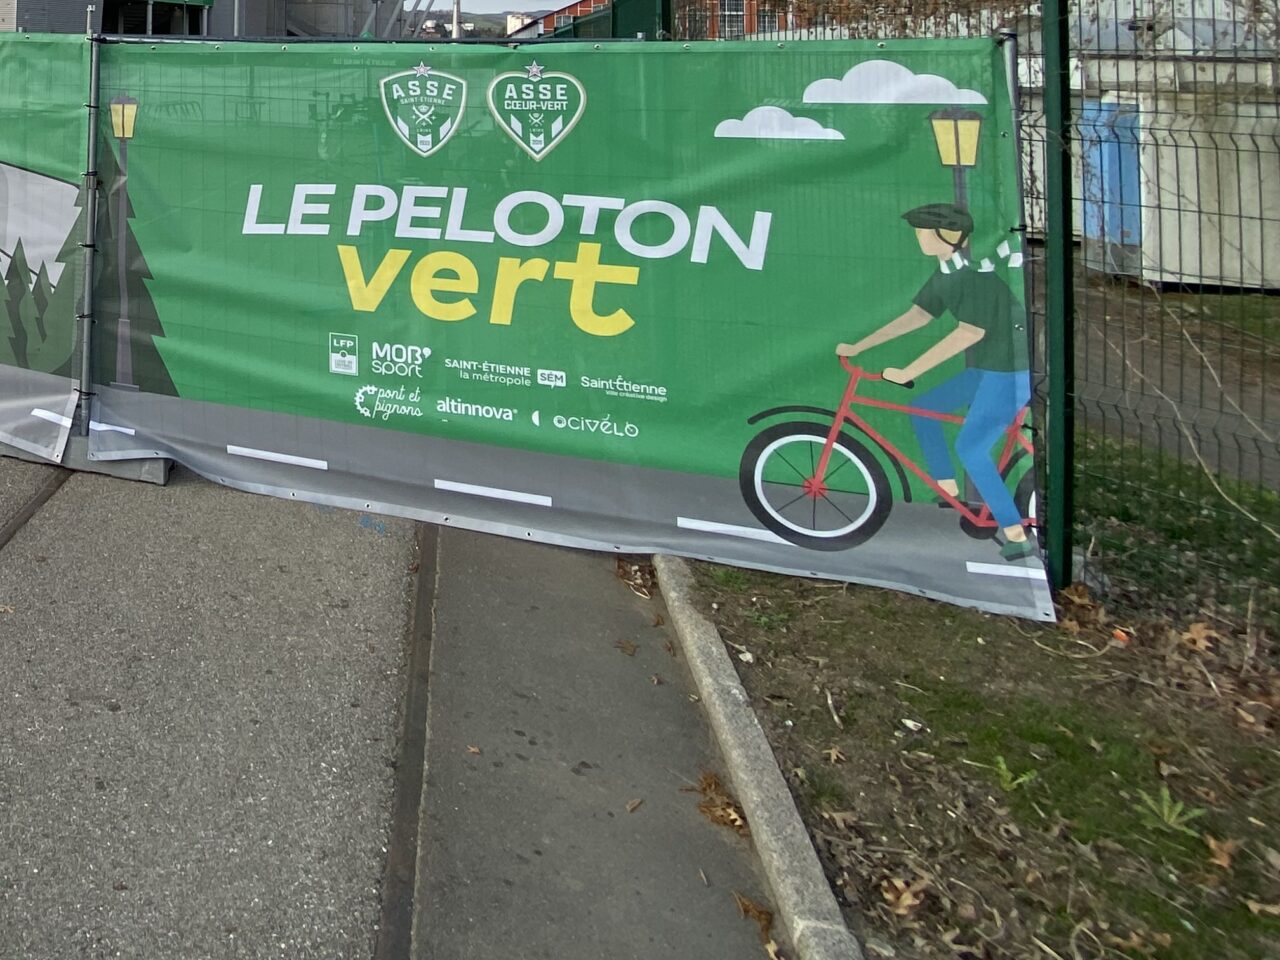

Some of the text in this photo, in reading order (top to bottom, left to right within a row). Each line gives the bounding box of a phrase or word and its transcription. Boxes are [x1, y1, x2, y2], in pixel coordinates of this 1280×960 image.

[392, 80, 457, 100] ASSE
[504, 83, 569, 100] ASSE
[504, 100, 569, 111] CŒUR-VERT
[241, 183, 773, 271] LE PELOTON
[336, 241, 640, 337] vert
[332, 338, 355, 348] LFP
[444, 358, 532, 377] SAINT-ÉTIENNE
[459, 370, 532, 387] la métropole
[539, 372, 564, 384] SÉM
[375, 384, 421, 403] pont et
[372, 399, 424, 420] pignons
[436, 396, 514, 421] altinnova
